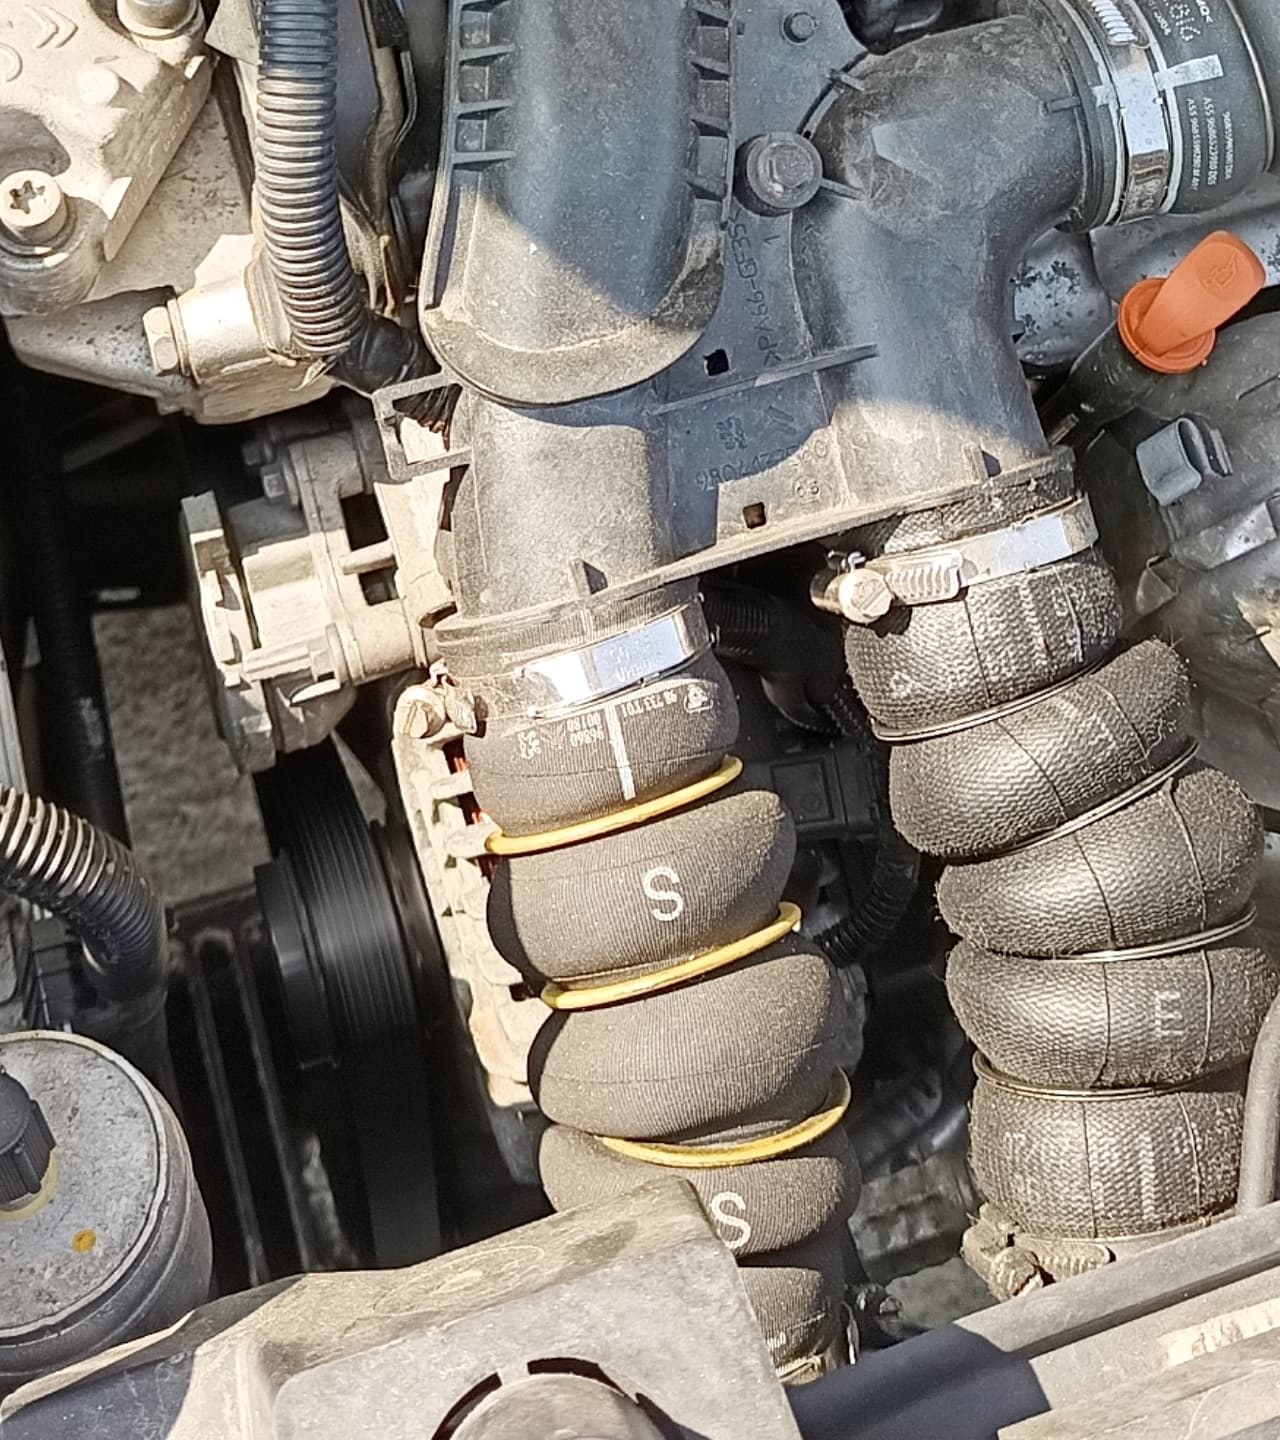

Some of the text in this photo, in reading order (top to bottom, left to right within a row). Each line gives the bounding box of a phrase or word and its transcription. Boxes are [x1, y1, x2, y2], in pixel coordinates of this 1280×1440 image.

[1186, 98, 1198, 117] ASS
[1202, 97, 1216, 117] ASS
[640, 864, 685, 923] S
[707, 1189, 753, 1250] S
